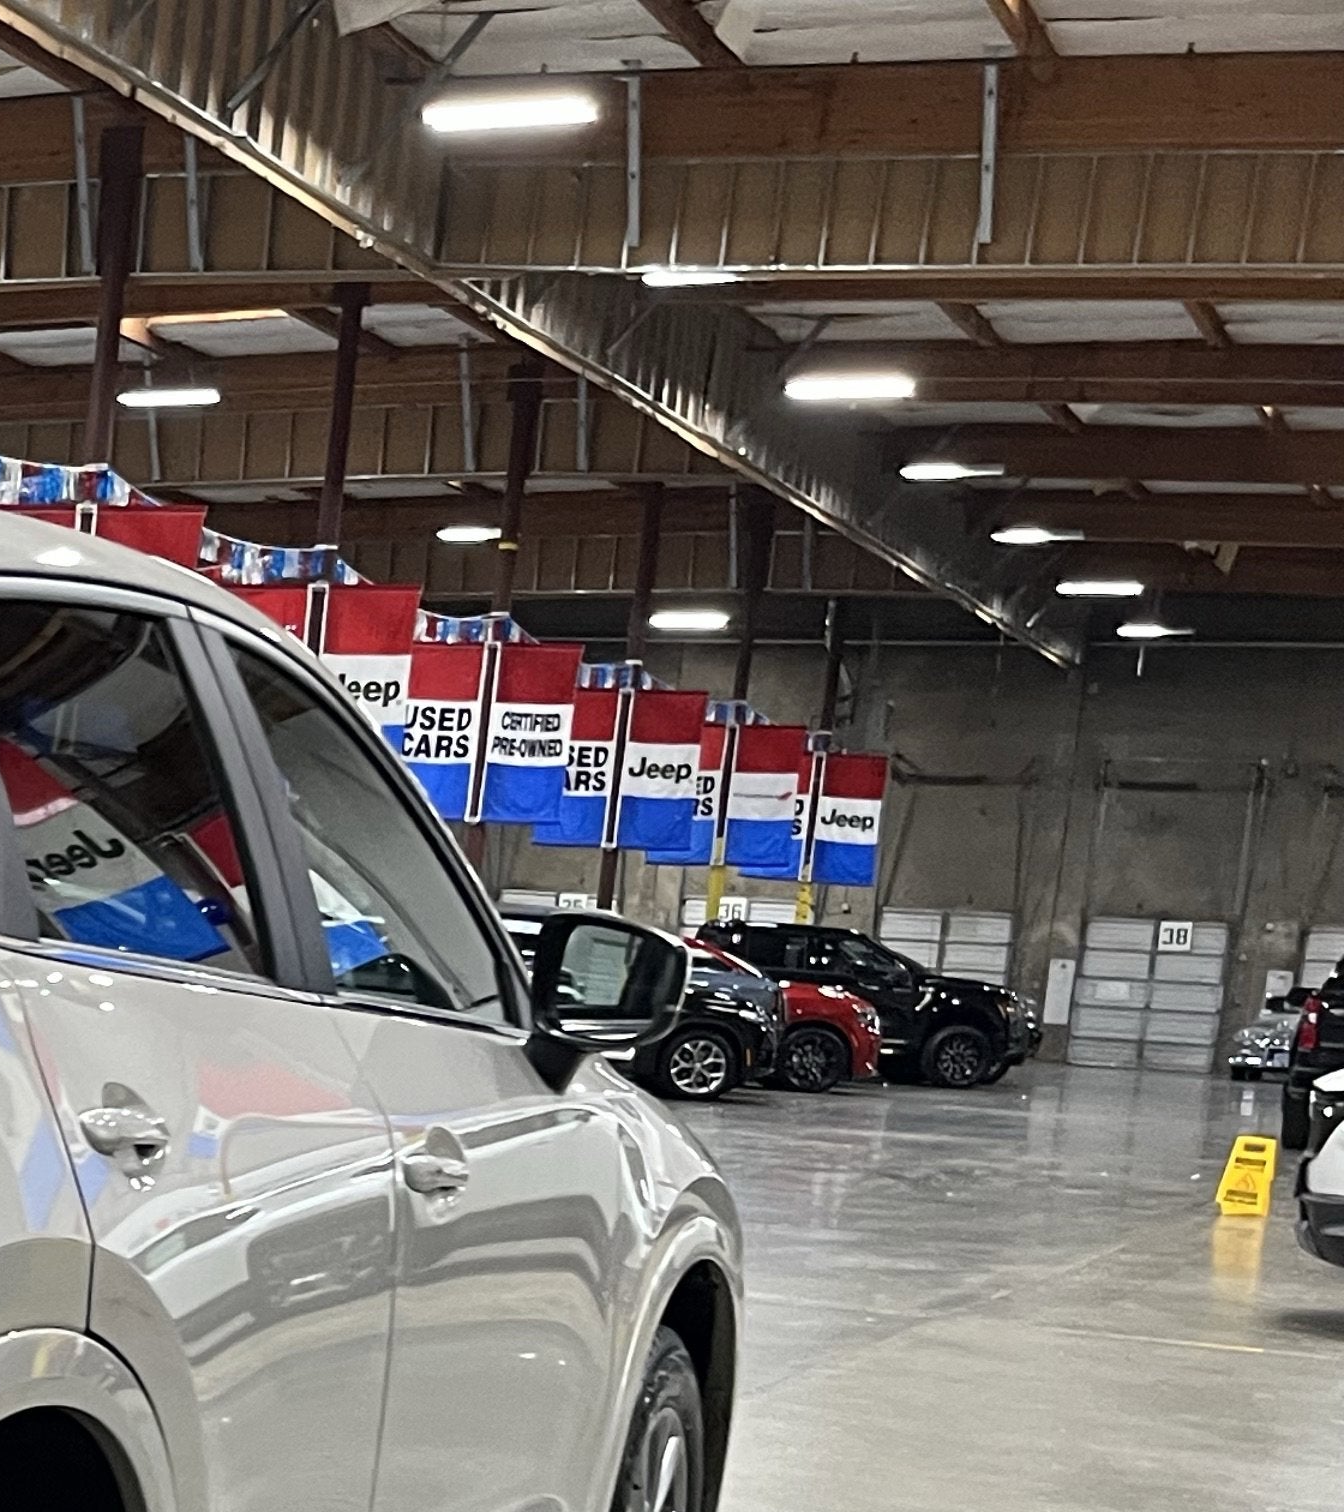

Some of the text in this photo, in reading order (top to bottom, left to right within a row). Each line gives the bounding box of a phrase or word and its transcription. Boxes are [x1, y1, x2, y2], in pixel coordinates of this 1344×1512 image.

[404, 704, 472, 731] USED
[501, 711, 561, 732] CERTIFIED
[402, 733, 470, 758] CARS
[628, 756, 692, 784] Jeep
[820, 809, 875, 832] Jeep
